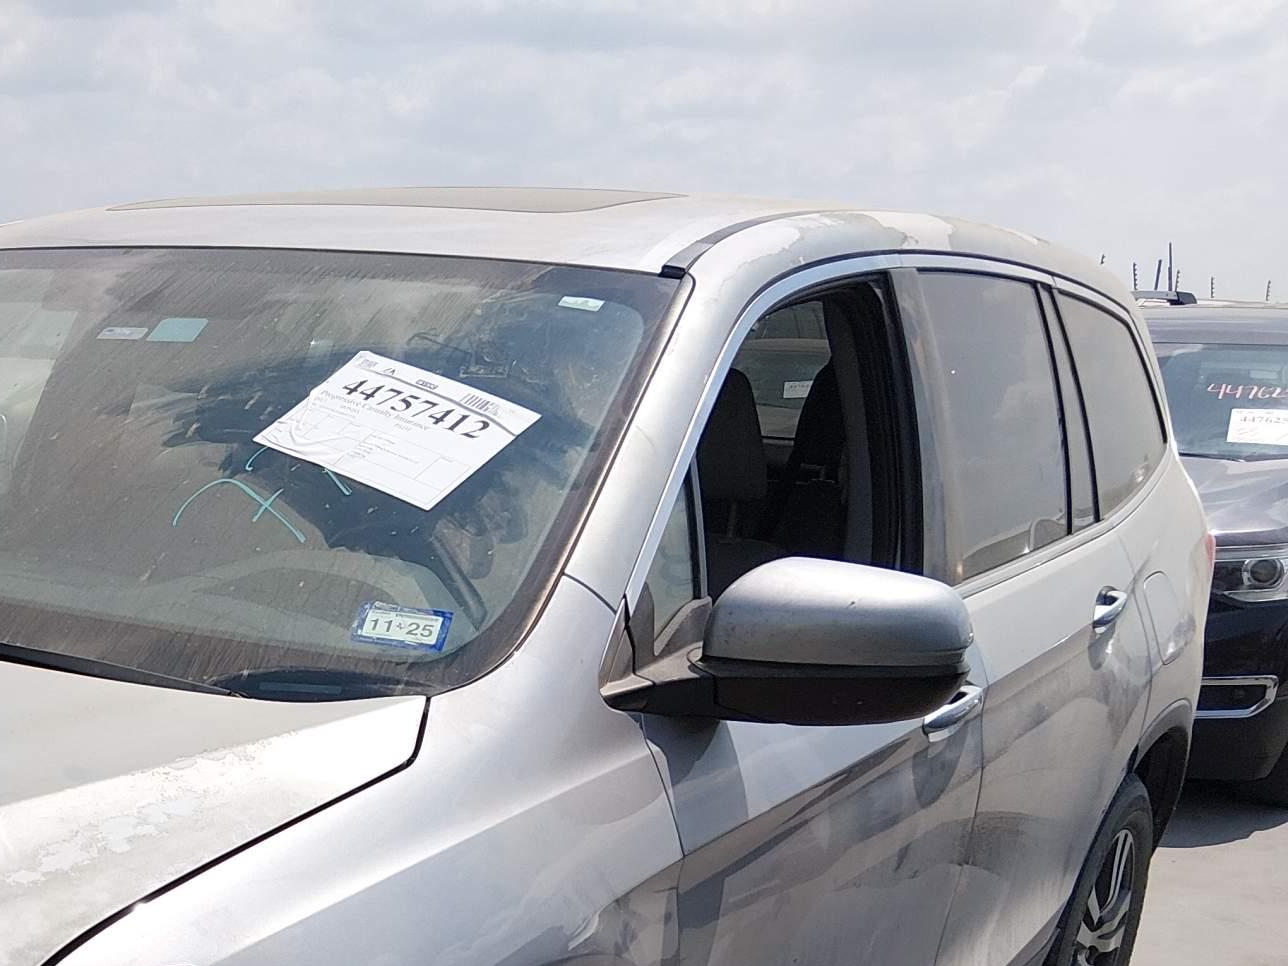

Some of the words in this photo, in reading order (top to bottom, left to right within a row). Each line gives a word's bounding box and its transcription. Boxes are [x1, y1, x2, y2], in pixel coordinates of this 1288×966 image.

[1207, 383, 1288, 400] 44762
[341, 379, 491, 440] 44757412
[406, 622, 435, 638] 25
